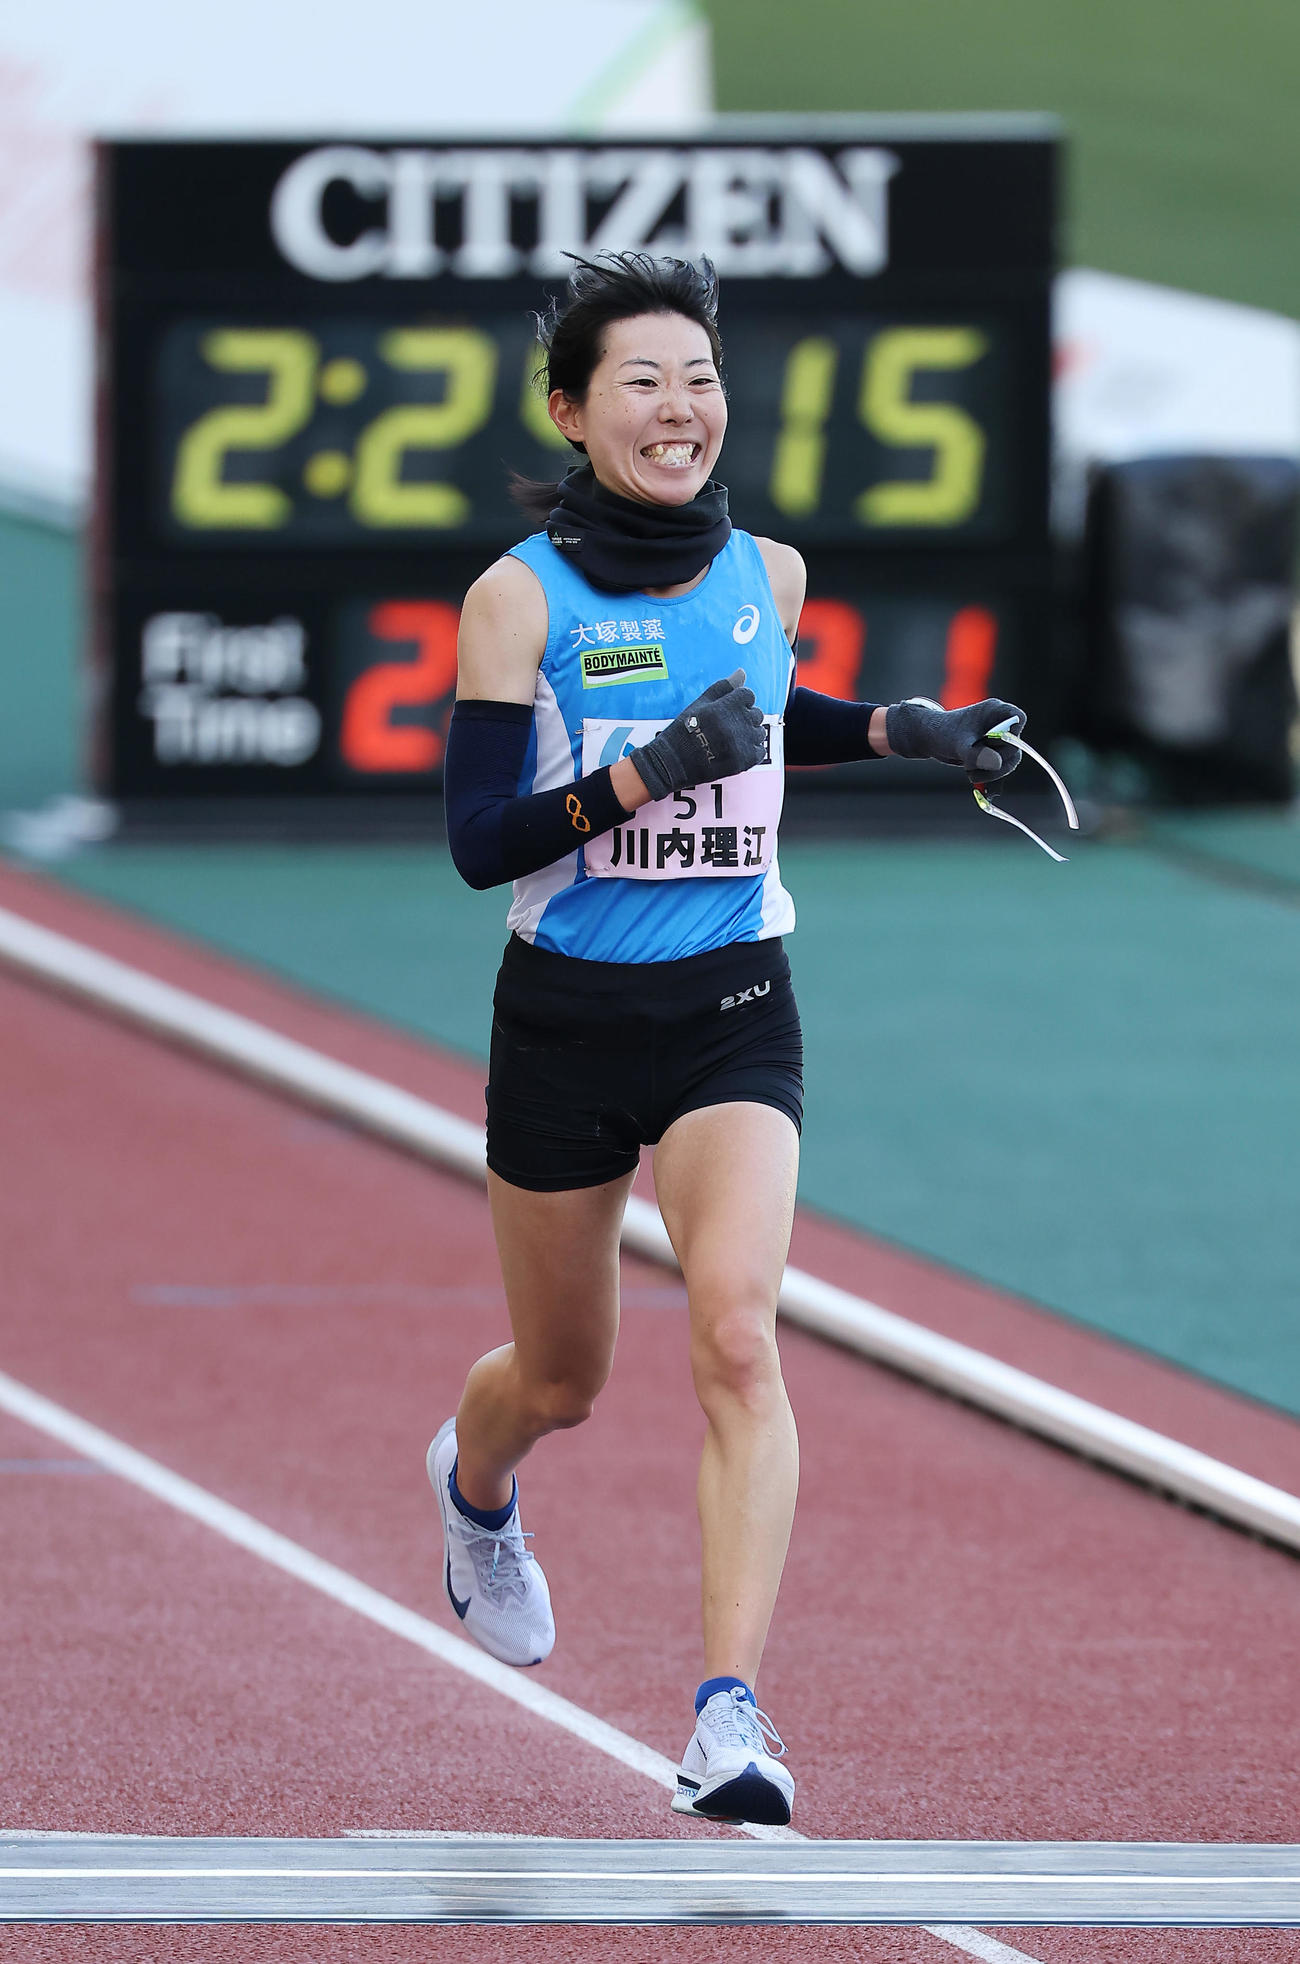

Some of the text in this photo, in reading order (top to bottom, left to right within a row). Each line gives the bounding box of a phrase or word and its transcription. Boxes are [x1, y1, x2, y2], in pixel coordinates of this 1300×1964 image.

[271, 146, 899, 281] CITIZEN
[769, 325, 986, 527] 15
[143, 612, 306, 690] First
[570, 618, 666, 649] 大塚製薬
[584, 647, 662, 670] BODYMAINTÉ
[140, 683, 321, 765] Time
[673, 784, 723, 820] 51
[610, 825, 767, 870] 川内理江
[720, 980, 770, 1011] 2XU
